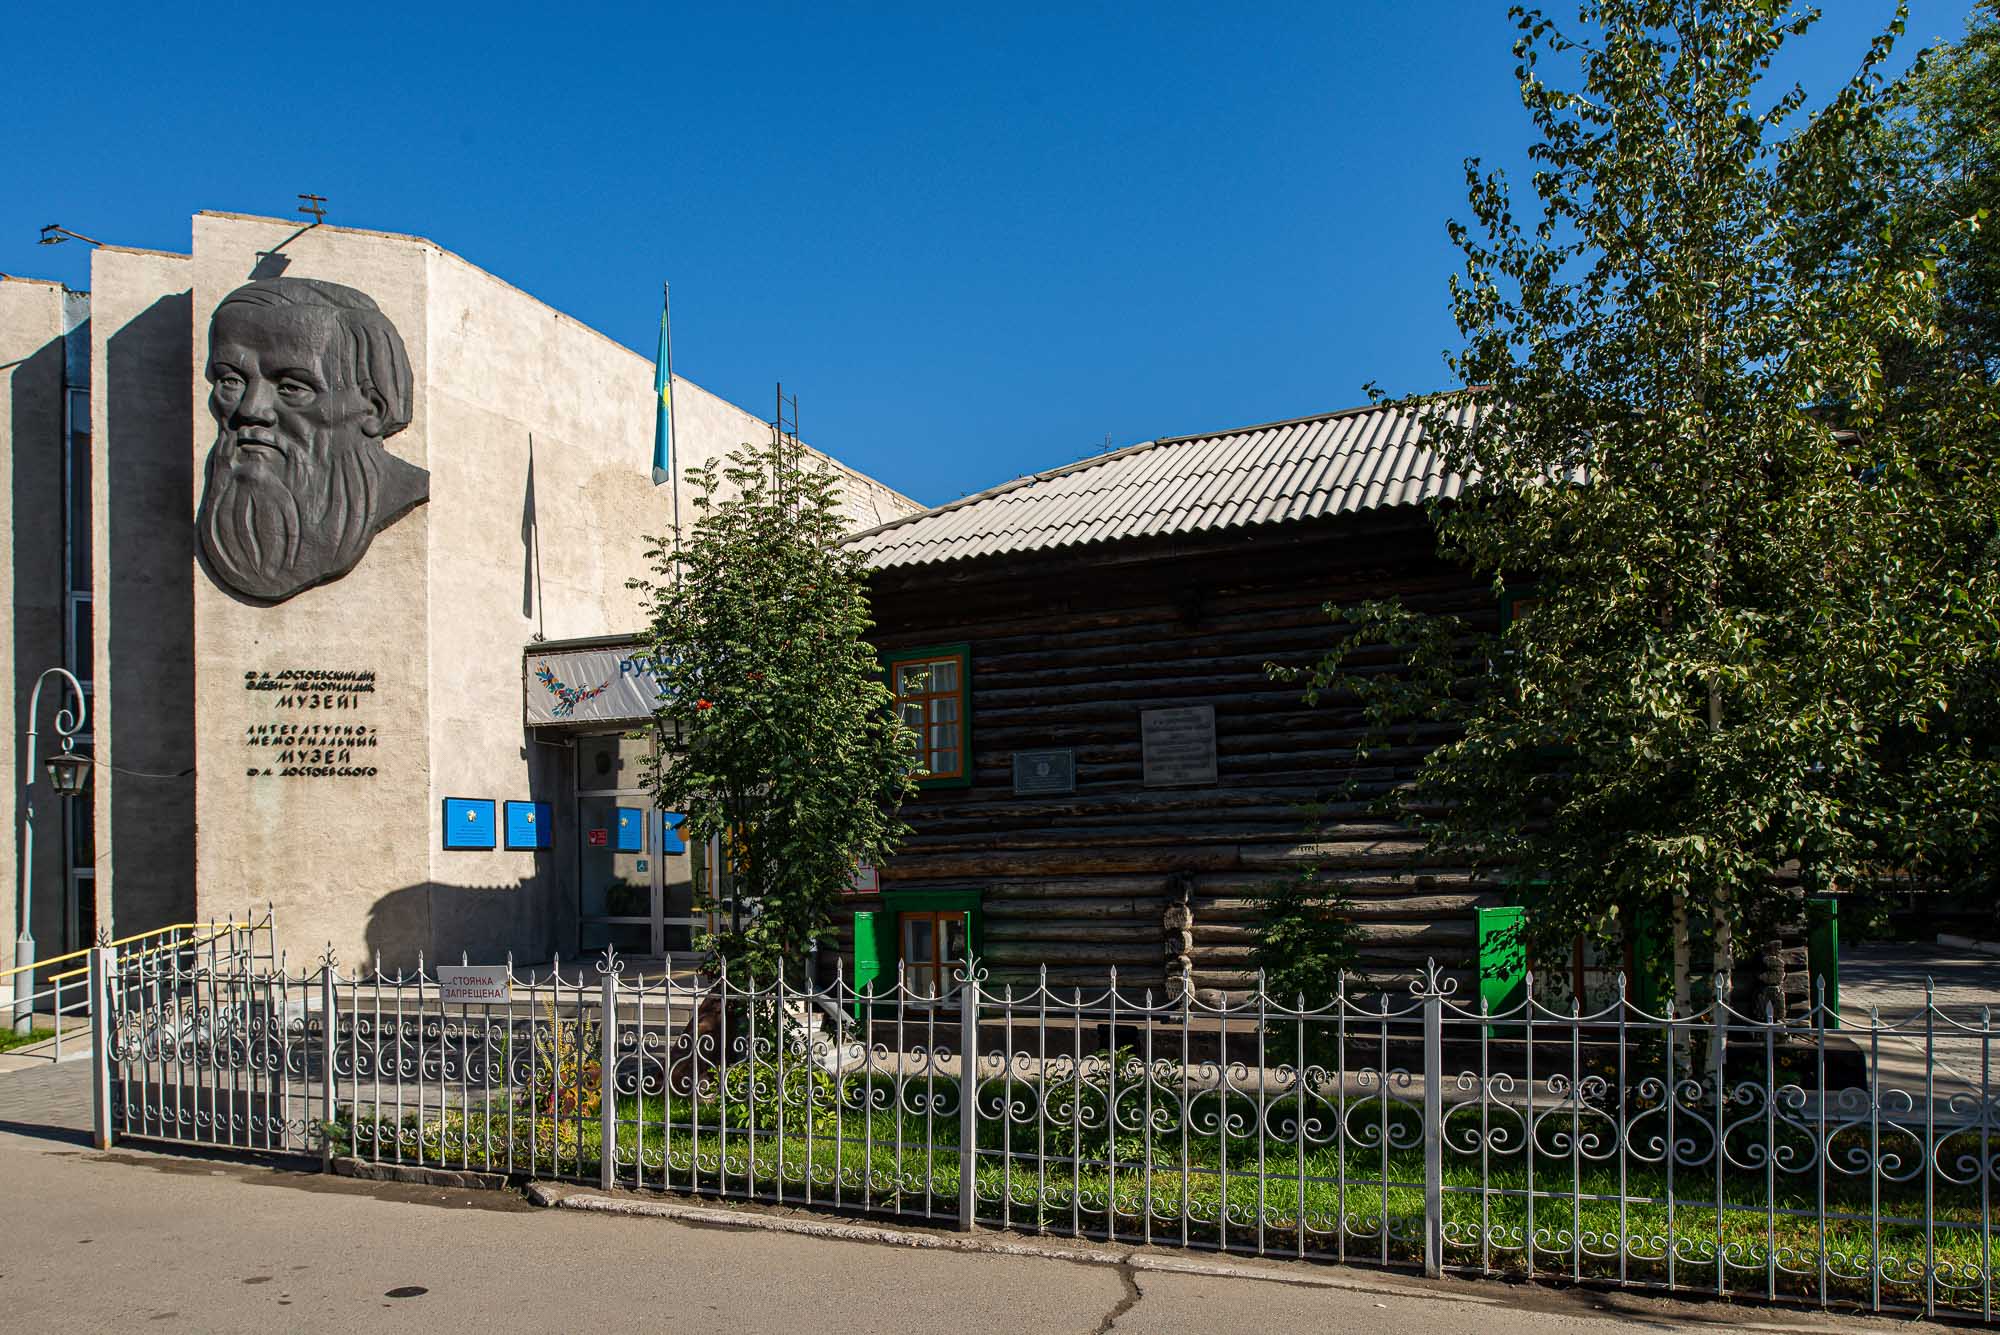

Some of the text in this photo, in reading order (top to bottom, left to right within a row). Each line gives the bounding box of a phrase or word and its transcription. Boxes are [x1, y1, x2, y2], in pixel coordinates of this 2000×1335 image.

[275, 694, 358, 709] МУЗЕЙІ
[247, 725, 377, 736] ЛИТЕРАТУРНО-
[246, 736, 377, 747] МЕМОРИАЛЬНЫЙ
[276, 748, 351, 764] МУЗЕЙ
[279, 767, 378, 777] ДОСТОЕВСКОГО
[453, 976, 494, 986] СТОЯНКА
